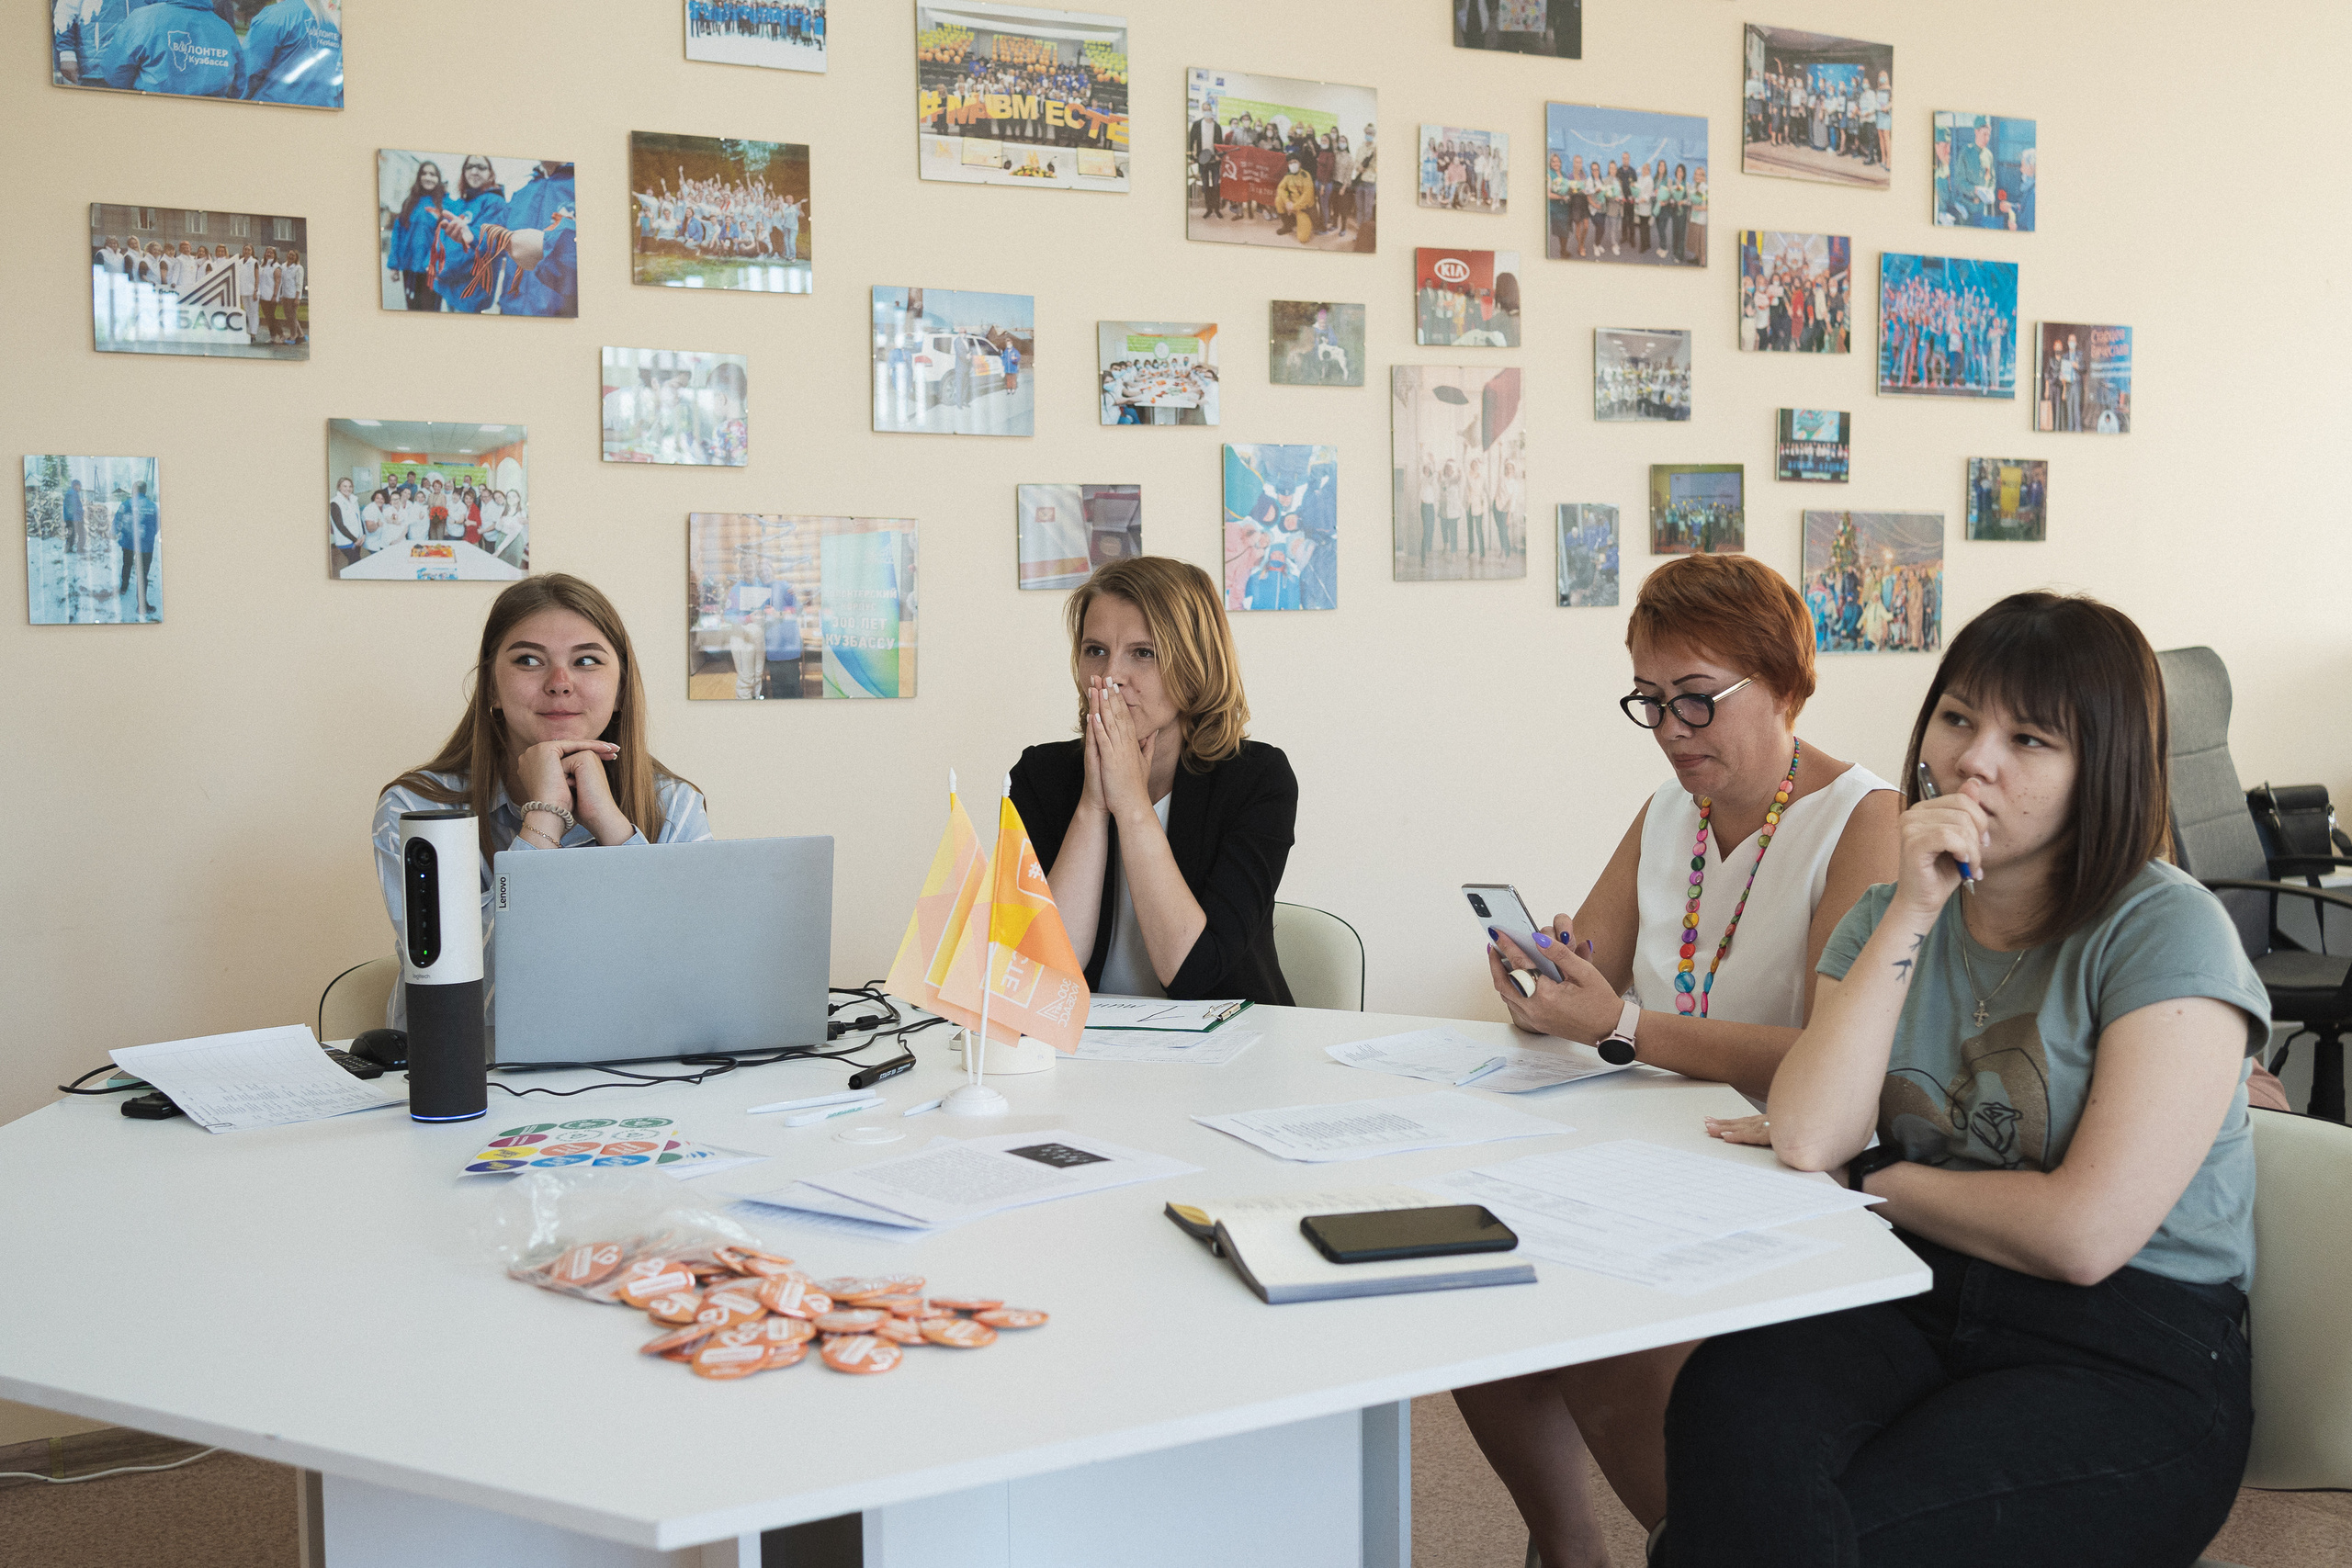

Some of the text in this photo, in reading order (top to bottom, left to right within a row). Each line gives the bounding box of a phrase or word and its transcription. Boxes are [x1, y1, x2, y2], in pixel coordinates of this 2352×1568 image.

[188, 55, 229, 67] Кузбасса
[1440, 264, 1465, 277] KIA
[159, 309, 243, 332] БАСС
[832, 616, 888, 630] 300 ЛЕТ
[825, 633, 896, 650] КУЗБАССУ
[499, 876, 507, 908] Lenovo
